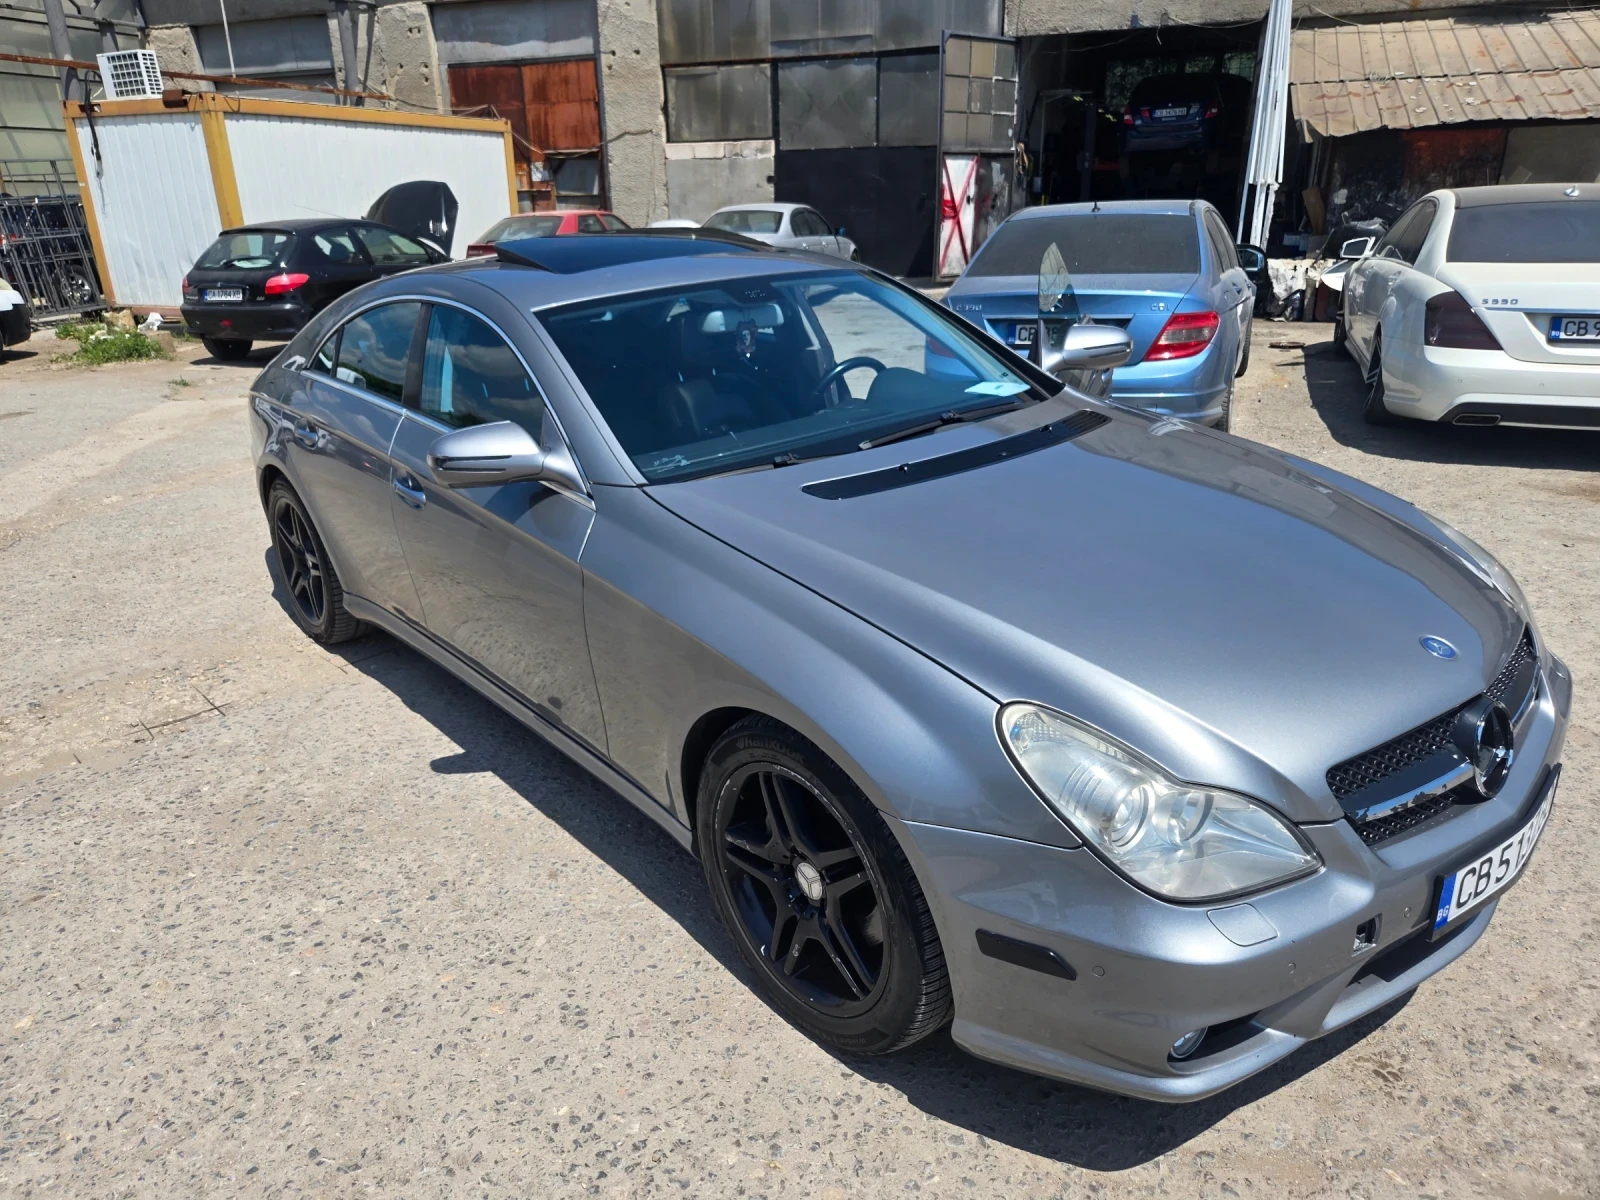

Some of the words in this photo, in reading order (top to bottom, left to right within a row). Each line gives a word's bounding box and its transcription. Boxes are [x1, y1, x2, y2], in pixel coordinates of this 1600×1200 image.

[1563, 320, 1589, 337] CB
[1455, 855, 1494, 910] CB
[1436, 904, 1450, 922] BG
